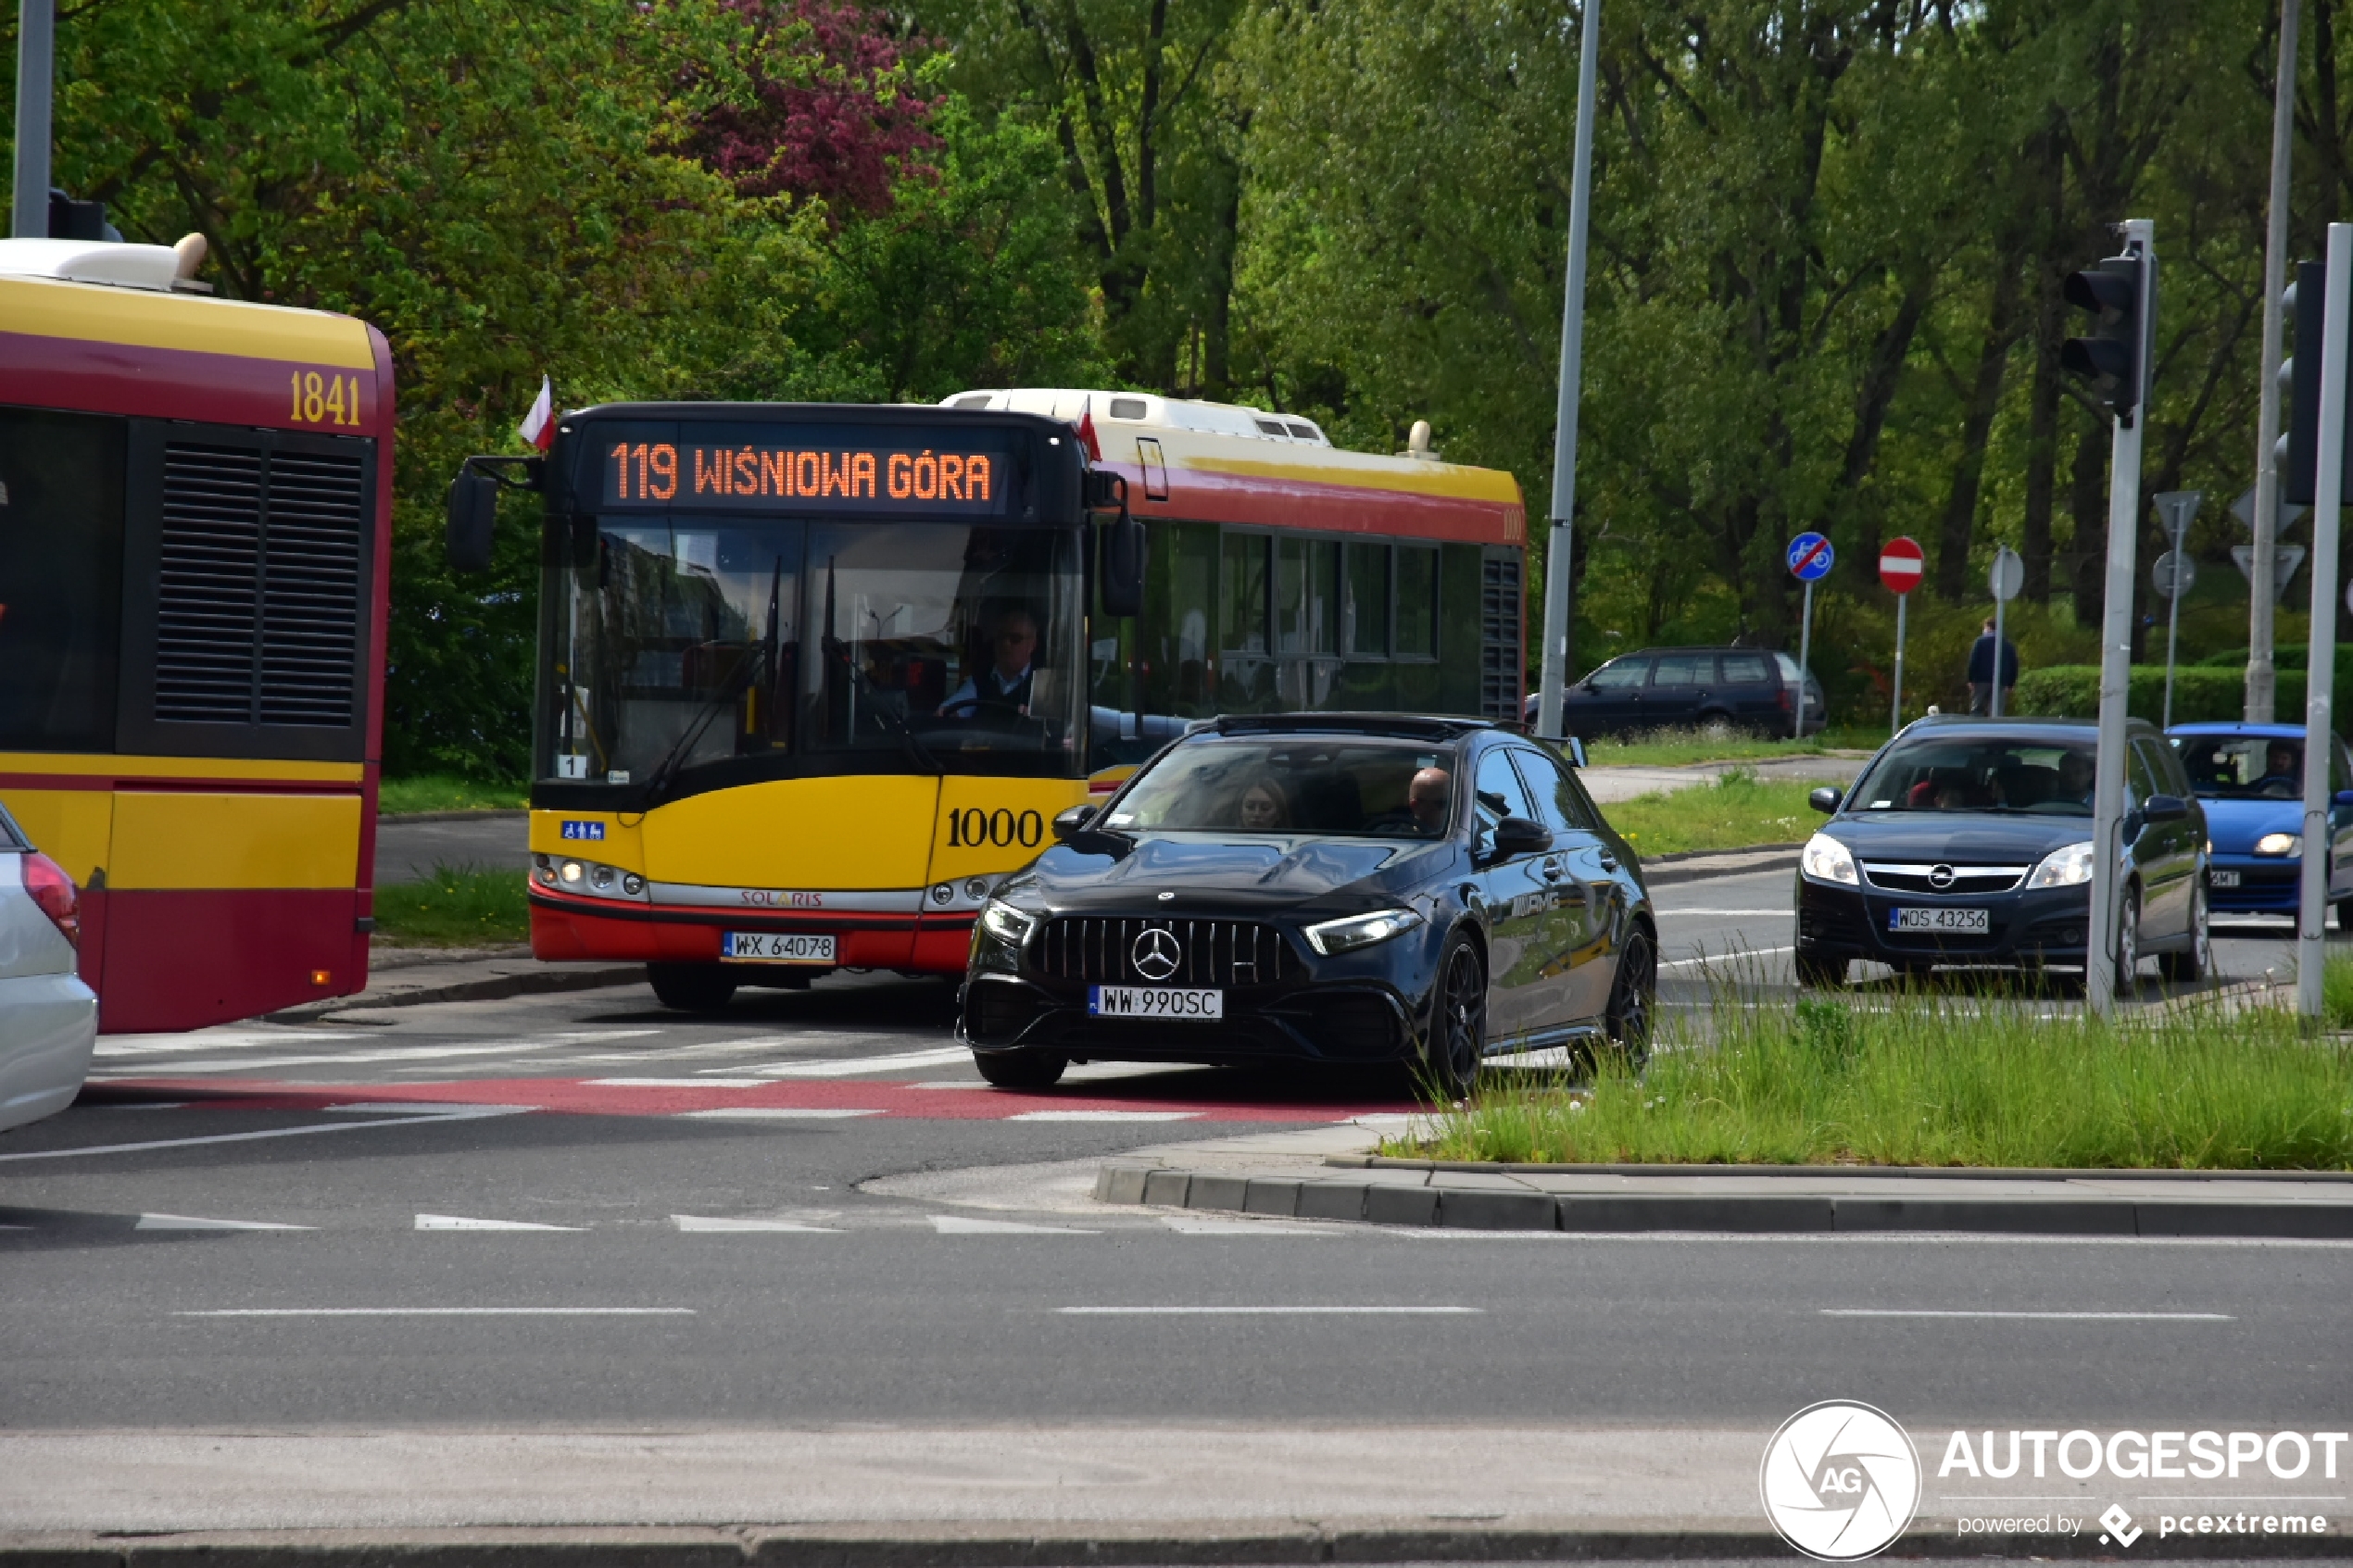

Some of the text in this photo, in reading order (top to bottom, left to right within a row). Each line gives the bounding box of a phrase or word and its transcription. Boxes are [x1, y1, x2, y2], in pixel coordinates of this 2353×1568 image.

[290, 370, 360, 426] 1841
[611, 442, 991, 500] 119 WIŚNIOWA GÓRA
[947, 808, 1043, 847] 1000
[740, 891, 822, 907] SOLARIS
[1899, 909, 1930, 927] WOS
[1935, 910, 1985, 928] 43256
[736, 935, 762, 955] WX
[771, 937, 832, 958] 64078
[1104, 989, 1132, 1013] WW
[1142, 990, 1215, 1015] 990SC
